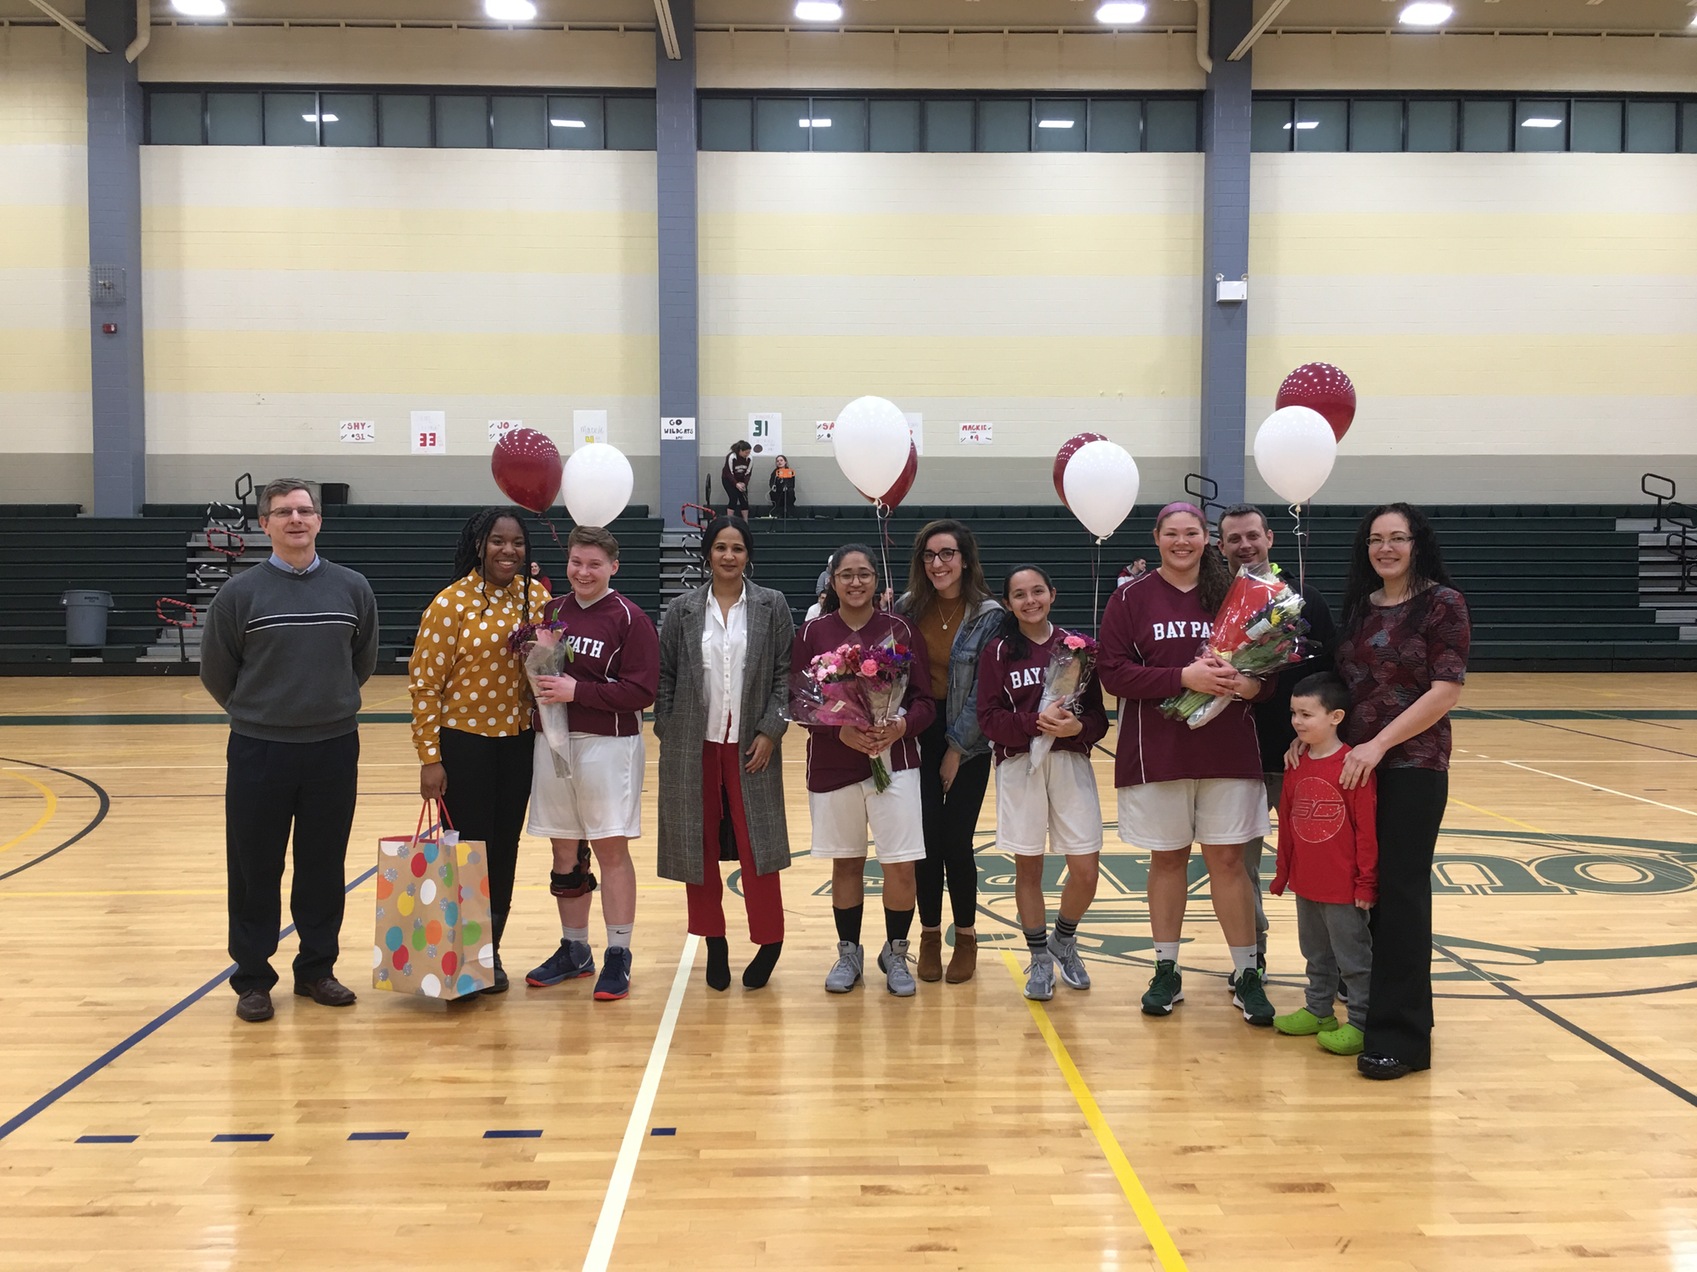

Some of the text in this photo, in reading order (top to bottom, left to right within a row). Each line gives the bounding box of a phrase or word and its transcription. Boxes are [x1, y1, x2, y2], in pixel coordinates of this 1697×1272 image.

[347, 422, 366, 430] SHY
[497, 421, 510, 430] JO
[752, 420, 769, 437] 31
[419, 432, 436, 447] 33
[1152, 621, 1214, 641] BAY PA
[566, 635, 605, 659] PATH
[1009, 666, 1041, 689] BAY
